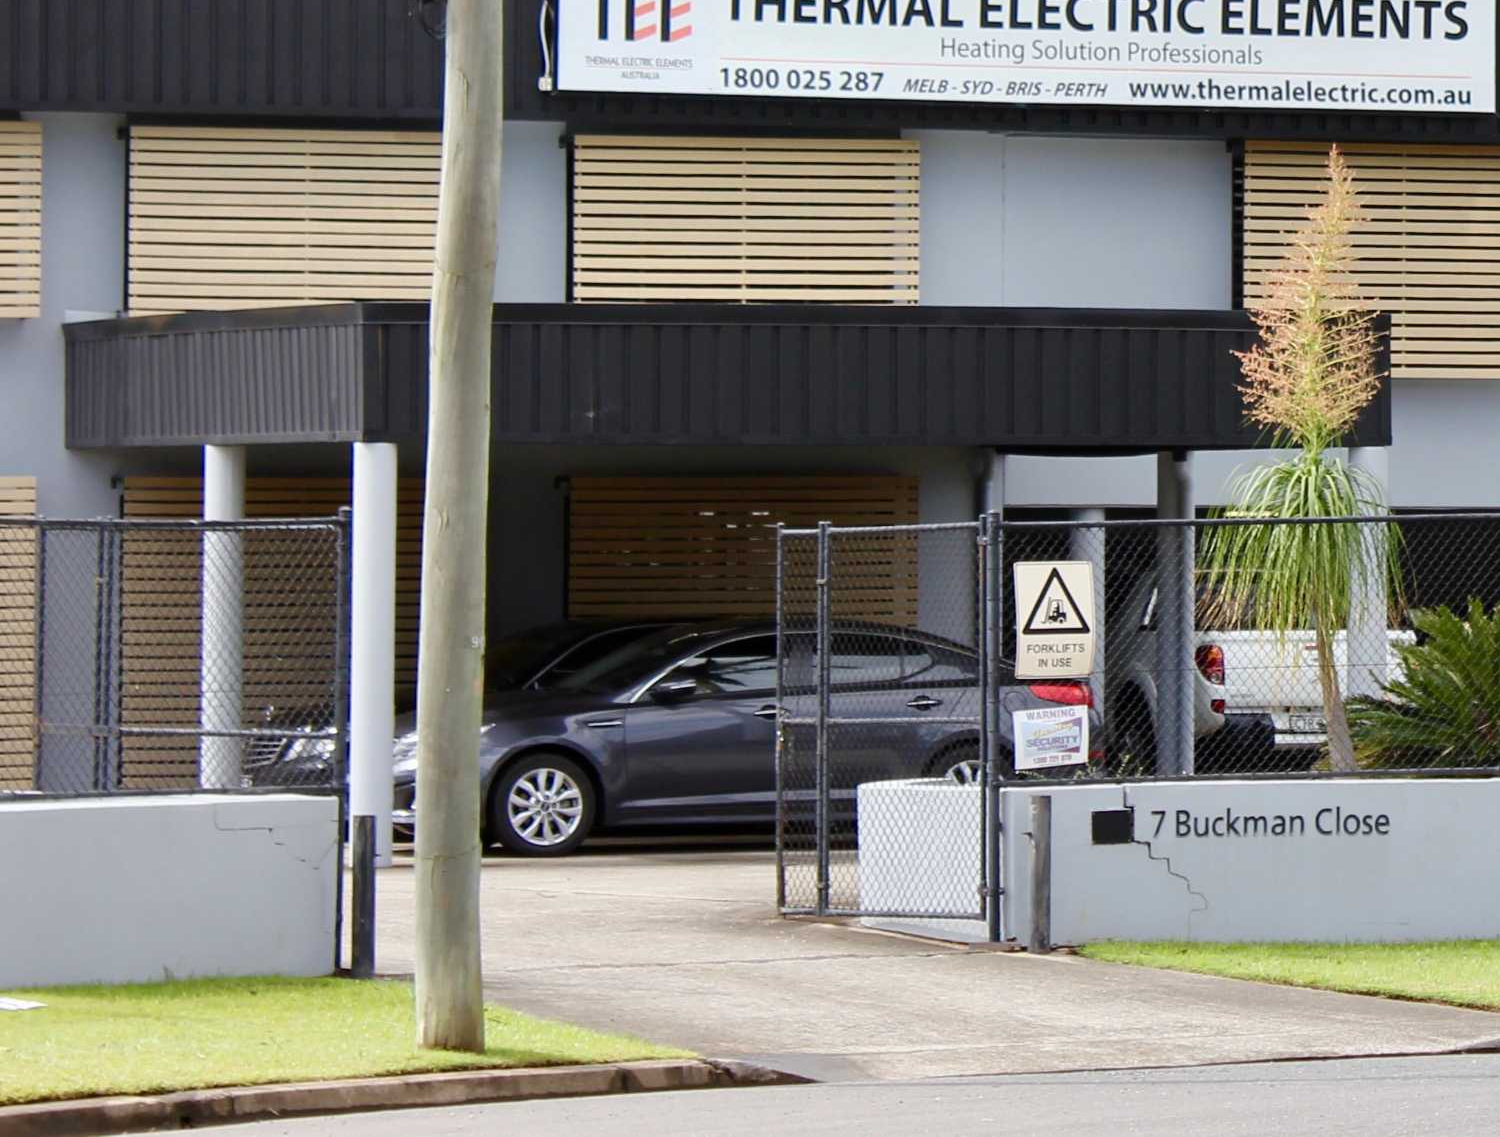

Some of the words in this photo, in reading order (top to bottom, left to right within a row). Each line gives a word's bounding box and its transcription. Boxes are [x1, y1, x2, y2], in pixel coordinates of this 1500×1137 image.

[941, 37, 1025, 64] Heating
[1032, 40, 1120, 62] Solution
[1128, 42, 1263, 66] Professionals
[585, 55, 620, 66] THERMAL
[622, 57, 655, 68] ELECTRIC
[656, 58, 693, 69] ELEMENTS
[621, 70, 661, 80] AUSTRALIA
[720, 67, 780, 89] 1800
[786, 69, 832, 91] 025
[839, 70, 884, 92] 287
[903, 78, 949, 94] MELB
[960, 80, 994, 96] SYD
[1005, 81, 1043, 97] BRIS
[1054, 82, 1108, 98] PERTH
[1128, 78, 1472, 105] www.thermalelectric.com.au
[1026, 643, 1085, 654] FORKLIFTS
[1038, 658, 1048, 668] IN
[1051, 657, 1072, 668] USE
[1025, 708, 1076, 721] WARNING
[1025, 735, 1078, 748] SECURITY
[1151, 810, 1167, 838] 7
[1175, 807, 1305, 838] Buckman
[1315, 805, 1390, 837] Close
